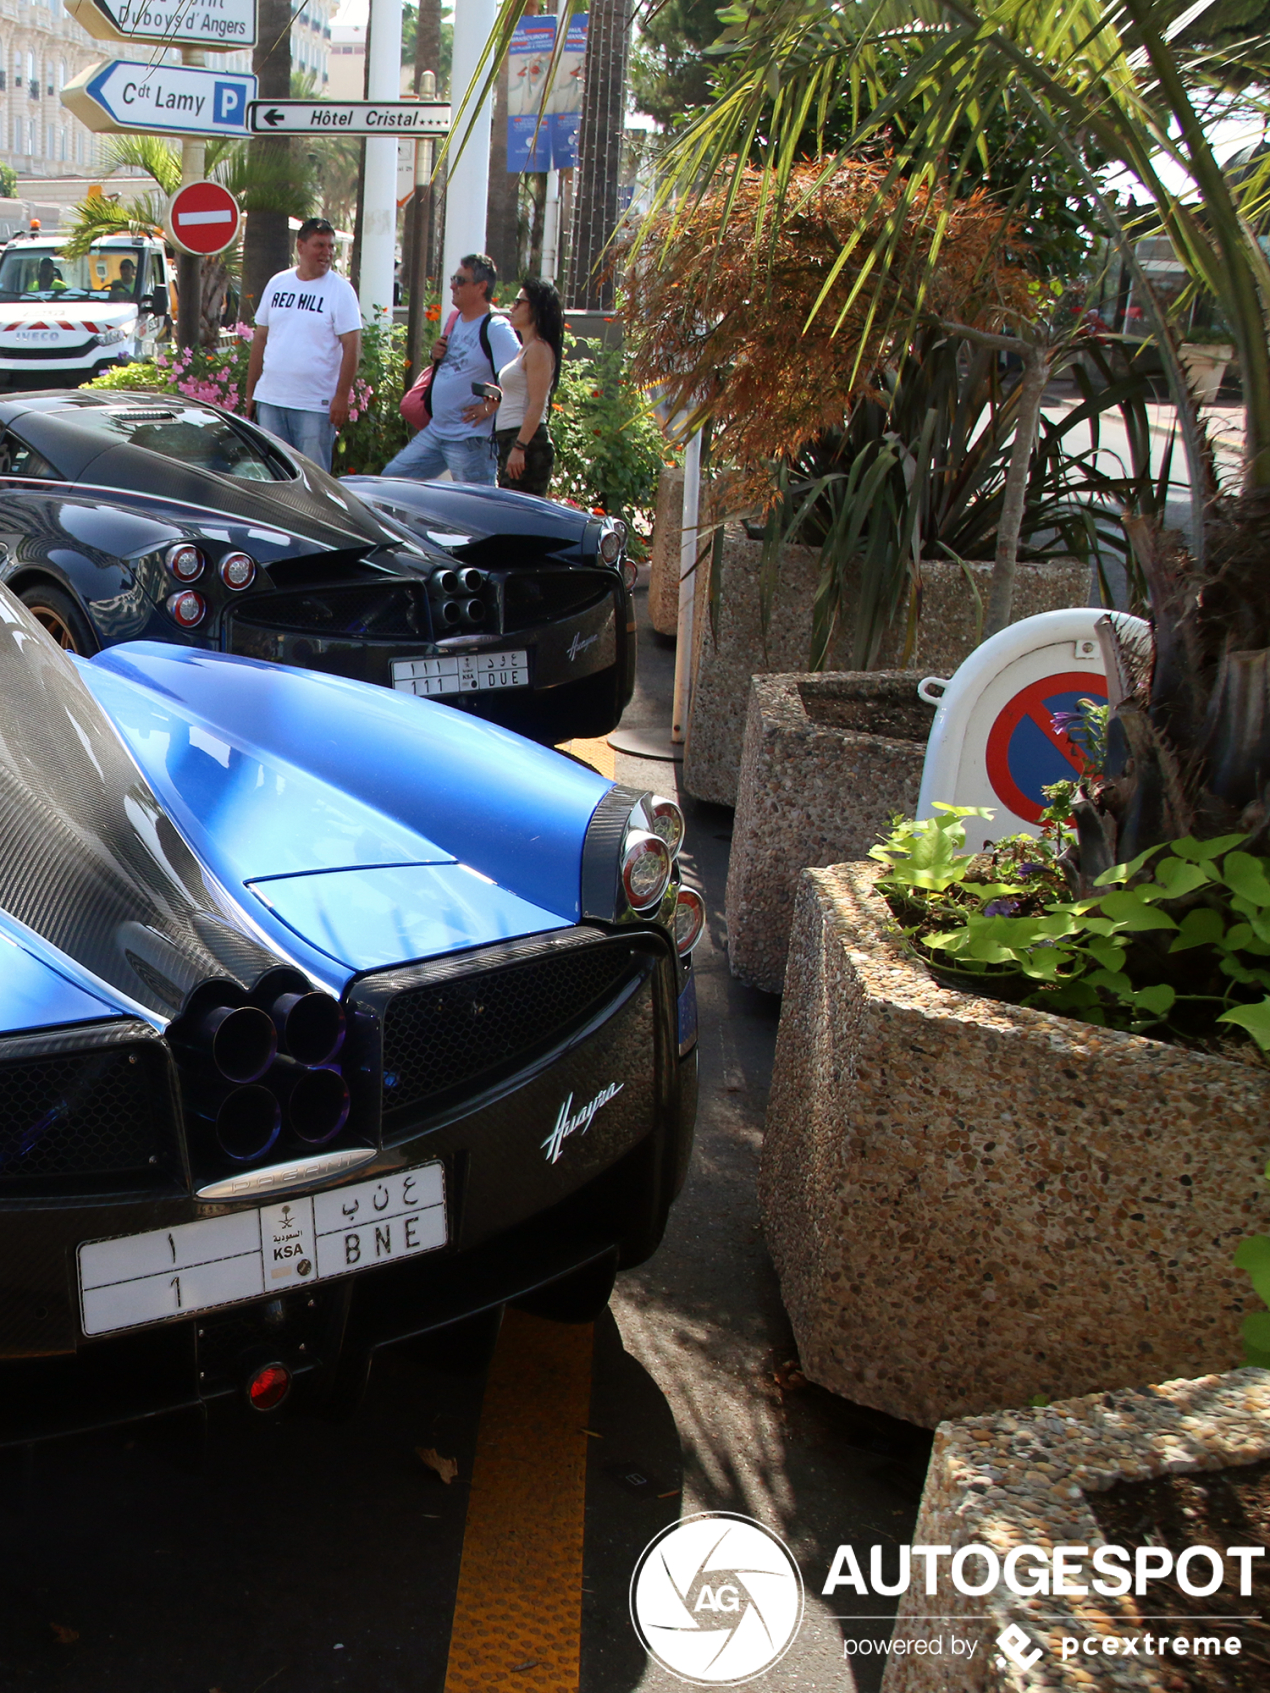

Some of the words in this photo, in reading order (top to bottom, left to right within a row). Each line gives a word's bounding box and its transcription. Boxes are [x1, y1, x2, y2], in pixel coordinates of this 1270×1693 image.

[118, 6, 182, 29] Duboys
[155, 86, 205, 117] Lamy
[310, 110, 354, 126] Hôtel
[366, 110, 419, 126] Cristal
[271, 292, 296, 308] RED
[297, 293, 324, 314] HILL
[16, 331, 60, 342] IVECO
[274, 1243, 304, 1261] KSA
